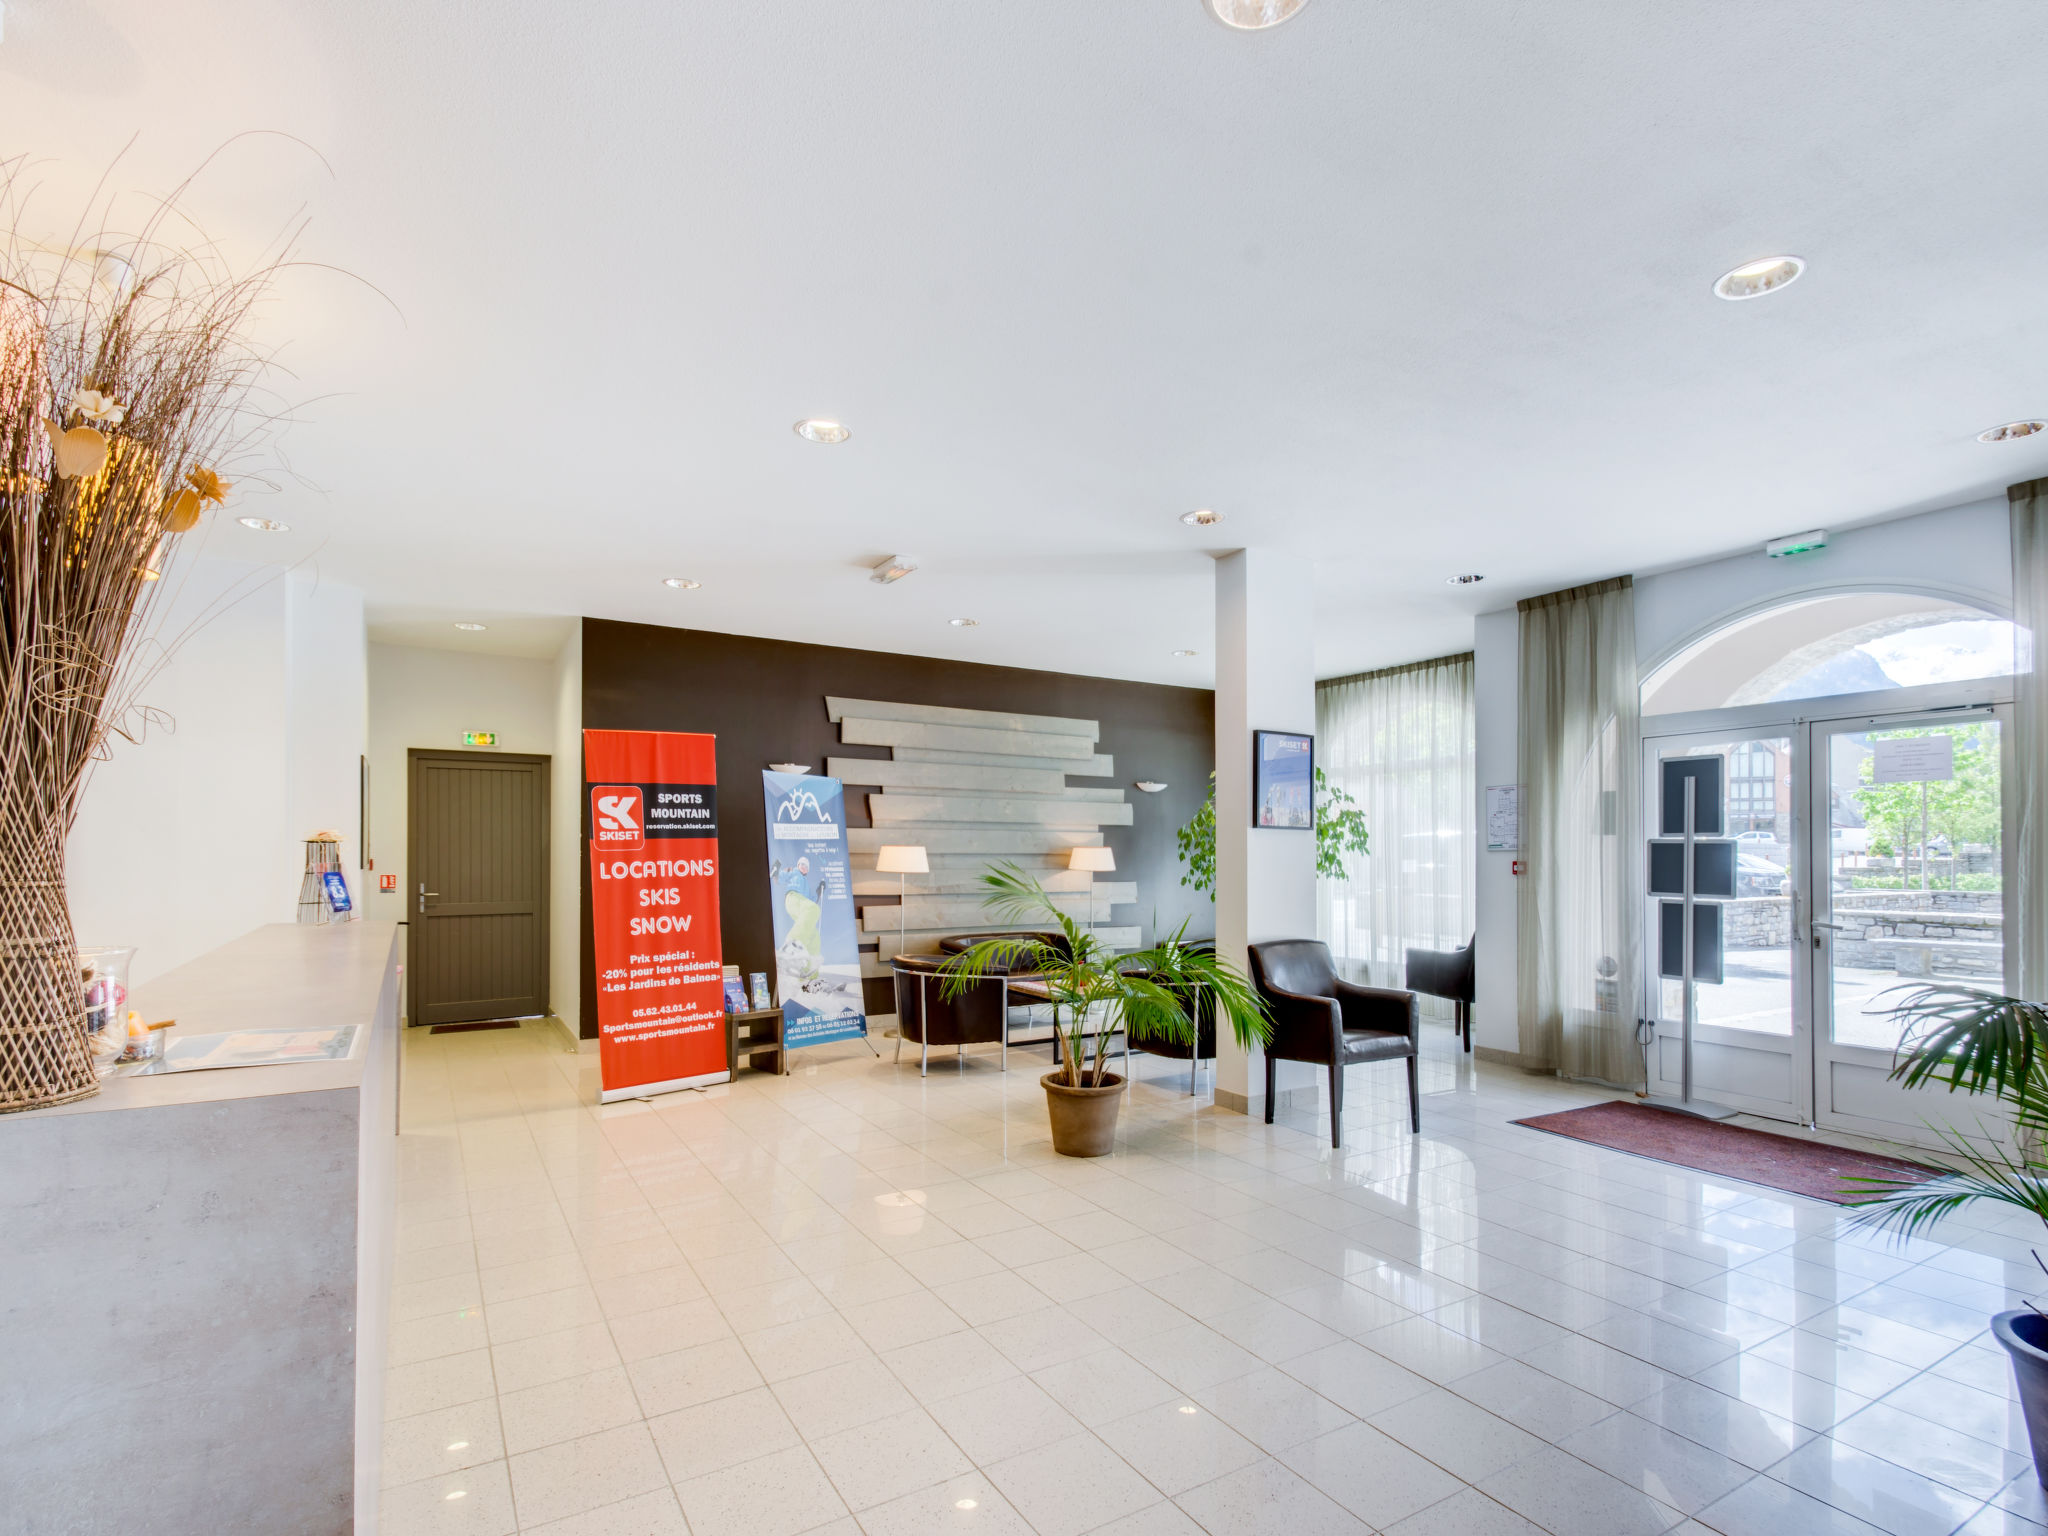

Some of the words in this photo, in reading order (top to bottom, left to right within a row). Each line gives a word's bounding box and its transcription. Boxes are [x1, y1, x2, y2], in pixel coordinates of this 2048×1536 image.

[658, 793, 703, 804] SPORTS
[651, 808, 710, 819] MOUNTAIN
[599, 831, 640, 841] SKISET
[600, 859, 715, 880] LOCATIONS
[639, 887, 681, 907] SKIS
[630, 914, 692, 936] SNOW
[629, 954, 651, 964] Prix
[653, 950, 690, 963] spécial
[602, 968, 628, 980] -20%
[630, 967, 654, 979] pour
[656, 965, 672, 974] les
[673, 960, 721, 973] résidents
[628, 978, 667, 991] Jardins
[668, 976, 681, 986] de
[632, 1002, 697, 1018] 05.62.43.01.44
[603, 1010, 723, 1034] Sportsmountain@outlook.fr
[613, 1022, 716, 1044] www.sportsmountain.fr
